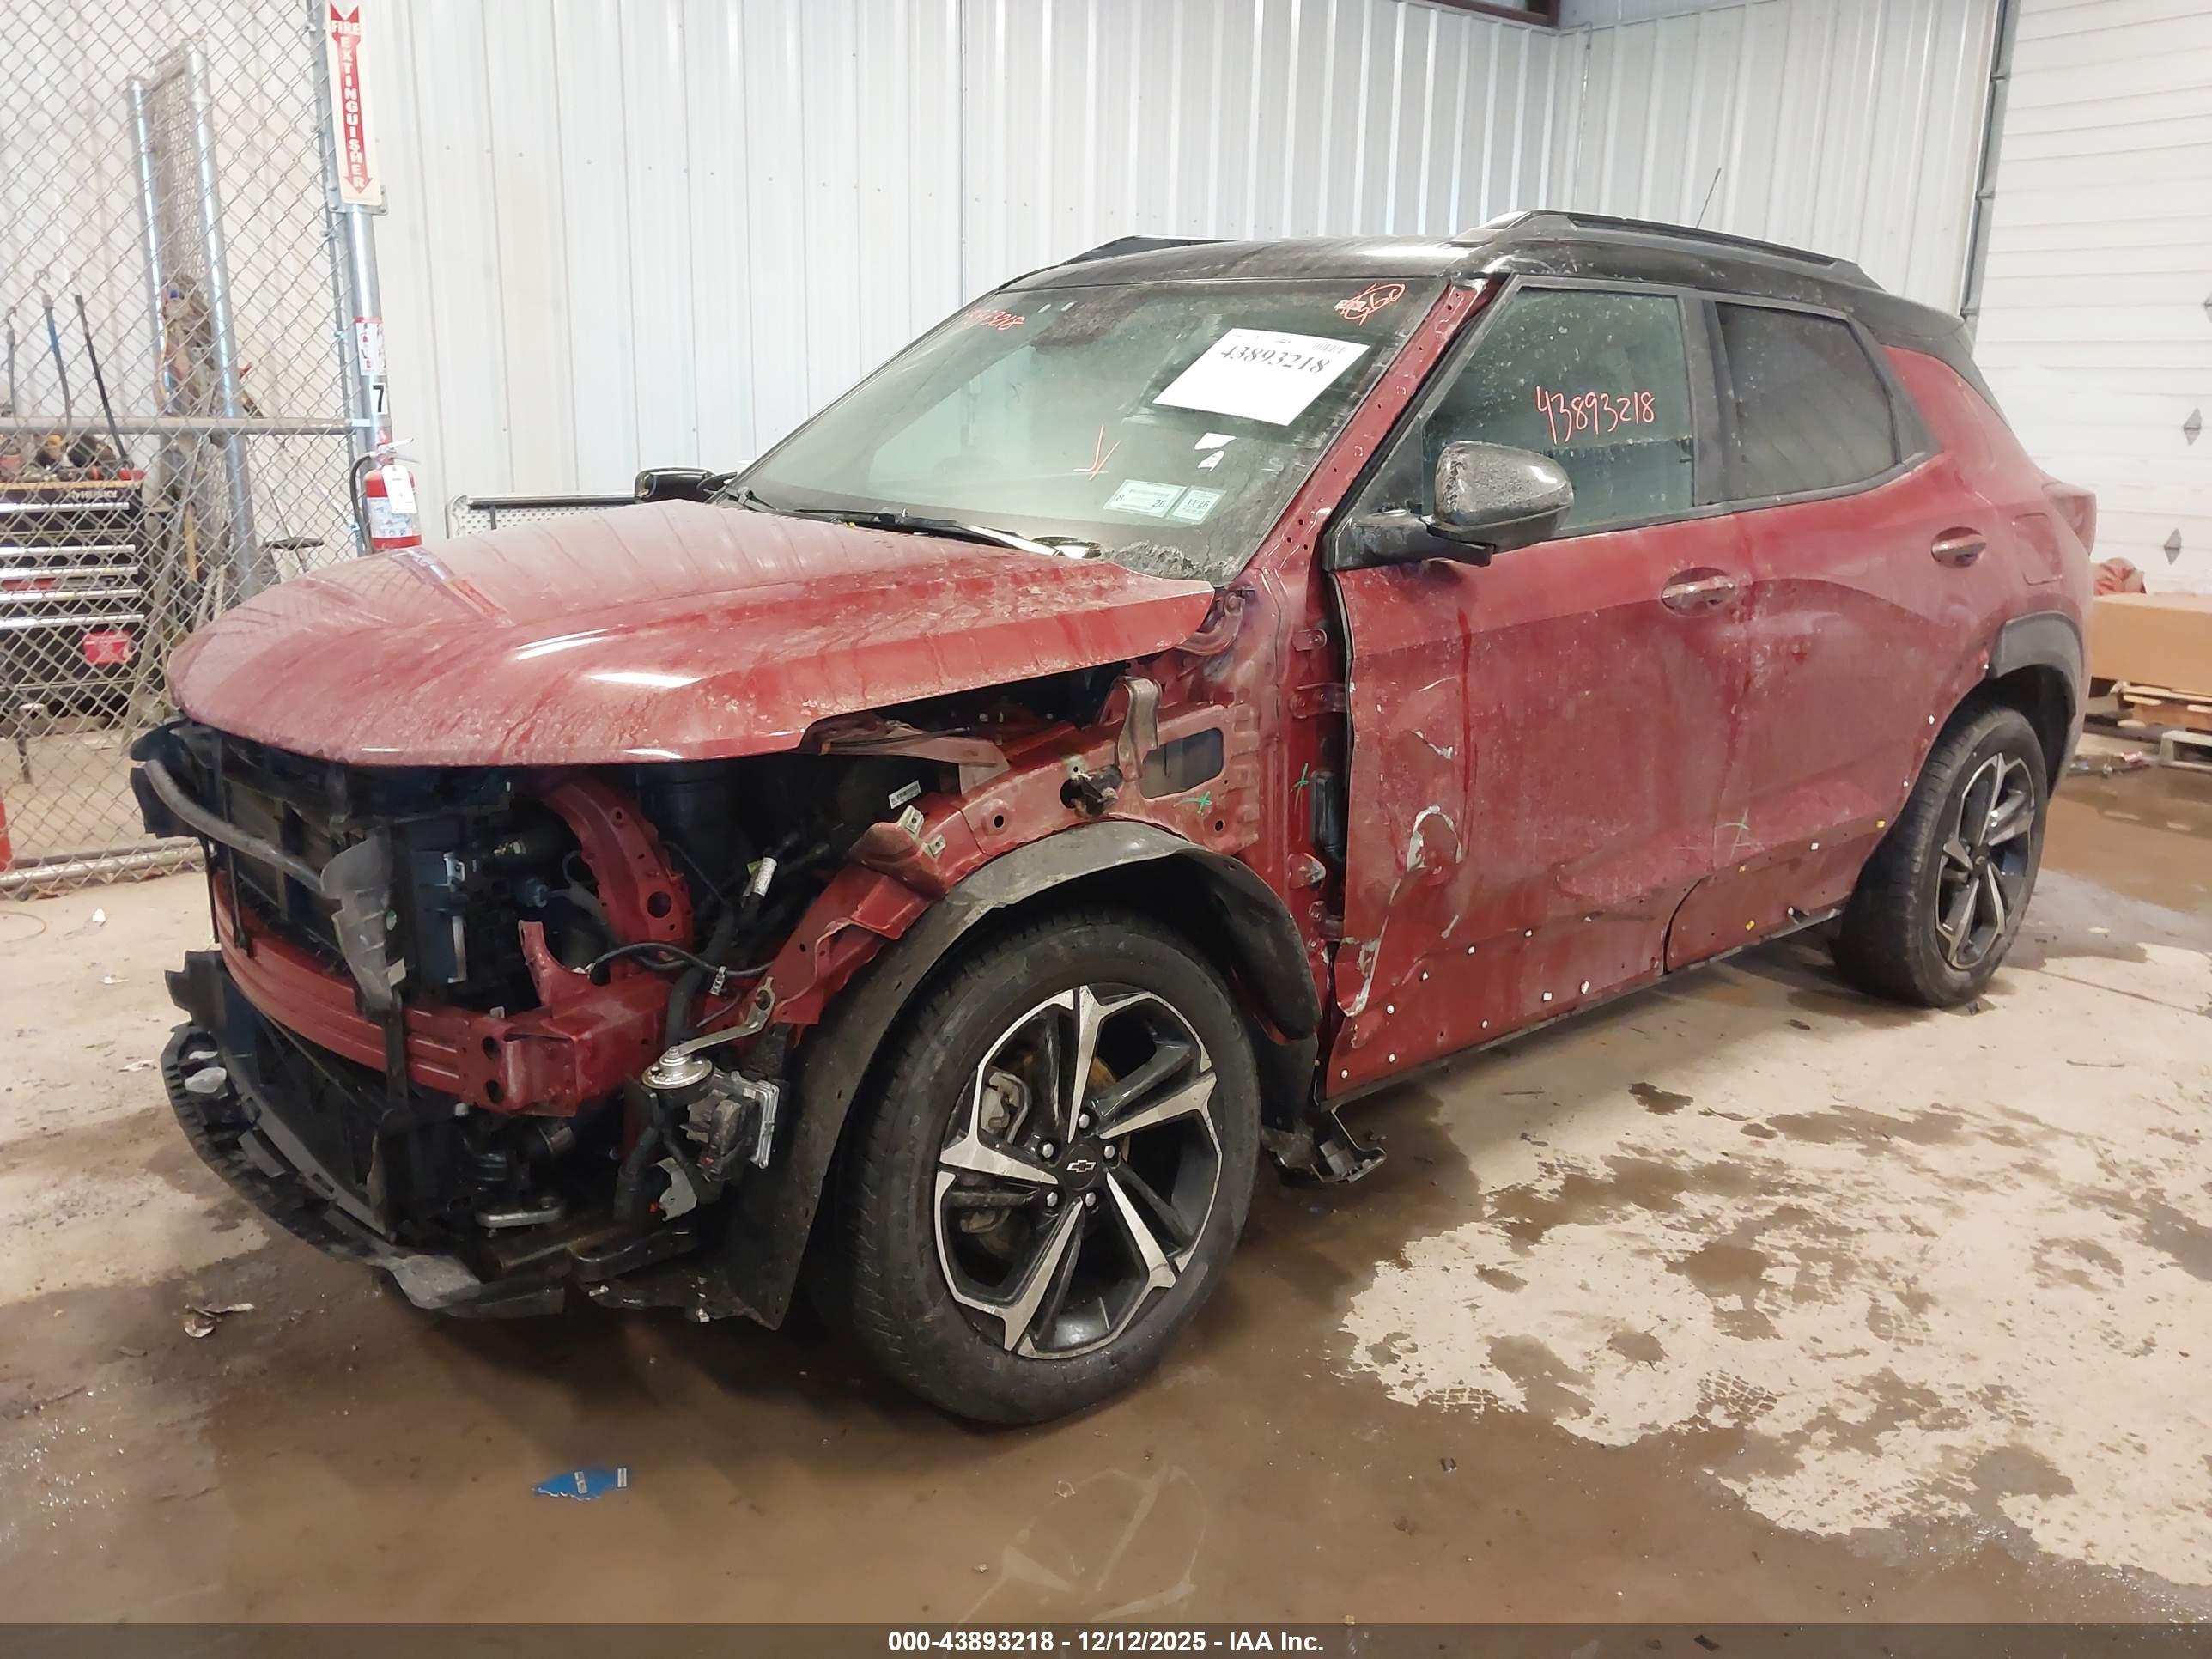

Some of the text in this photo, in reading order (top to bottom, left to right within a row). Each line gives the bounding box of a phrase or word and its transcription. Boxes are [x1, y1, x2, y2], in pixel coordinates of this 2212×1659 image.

[331, 20, 361, 34] FIRE
[340, 36, 365, 188] EXTINGUISHER
[1221, 345, 1330, 373] 43893218
[373, 385, 384, 412] 7
[1536, 386, 1656, 445] 43893218
